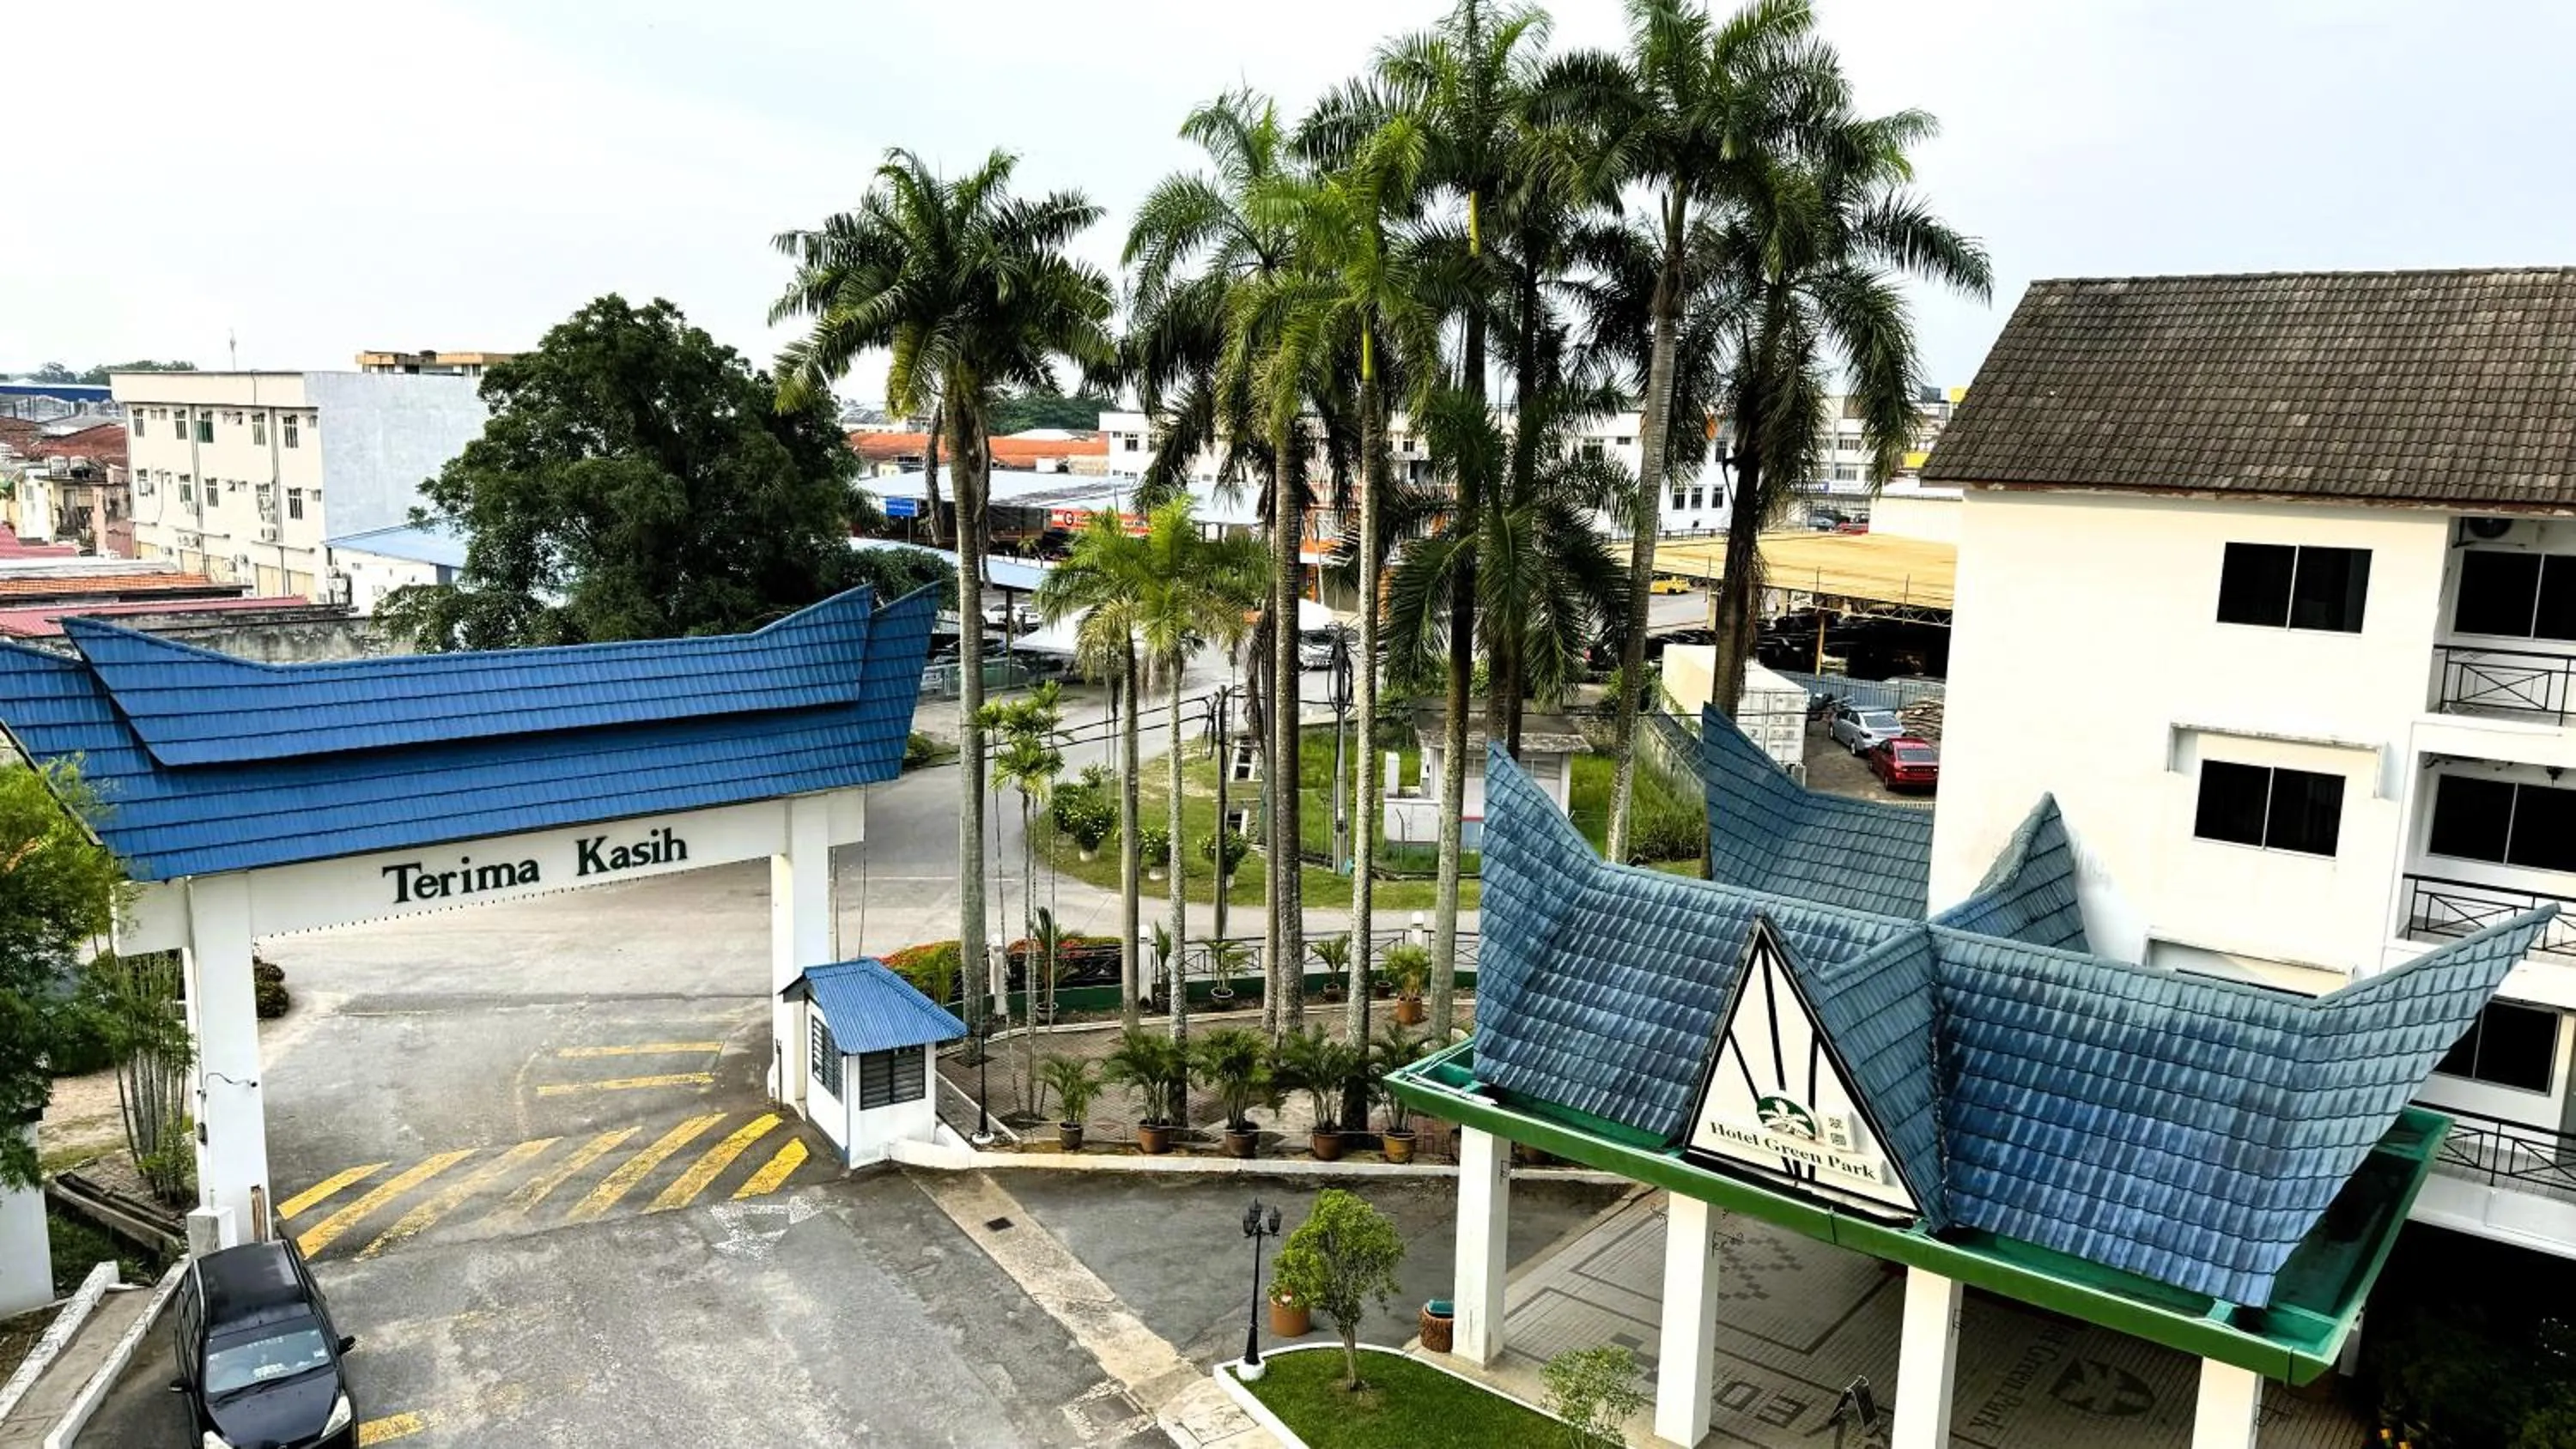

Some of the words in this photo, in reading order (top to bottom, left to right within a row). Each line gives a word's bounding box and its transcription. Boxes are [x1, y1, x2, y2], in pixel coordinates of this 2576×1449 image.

[382, 856, 540, 904] Terima
[576, 828, 688, 876] Kasih
[1710, 1121, 1760, 1147] Hotel
[1765, 1138, 1823, 1164] Green
[1828, 1155, 1876, 1180] Park
